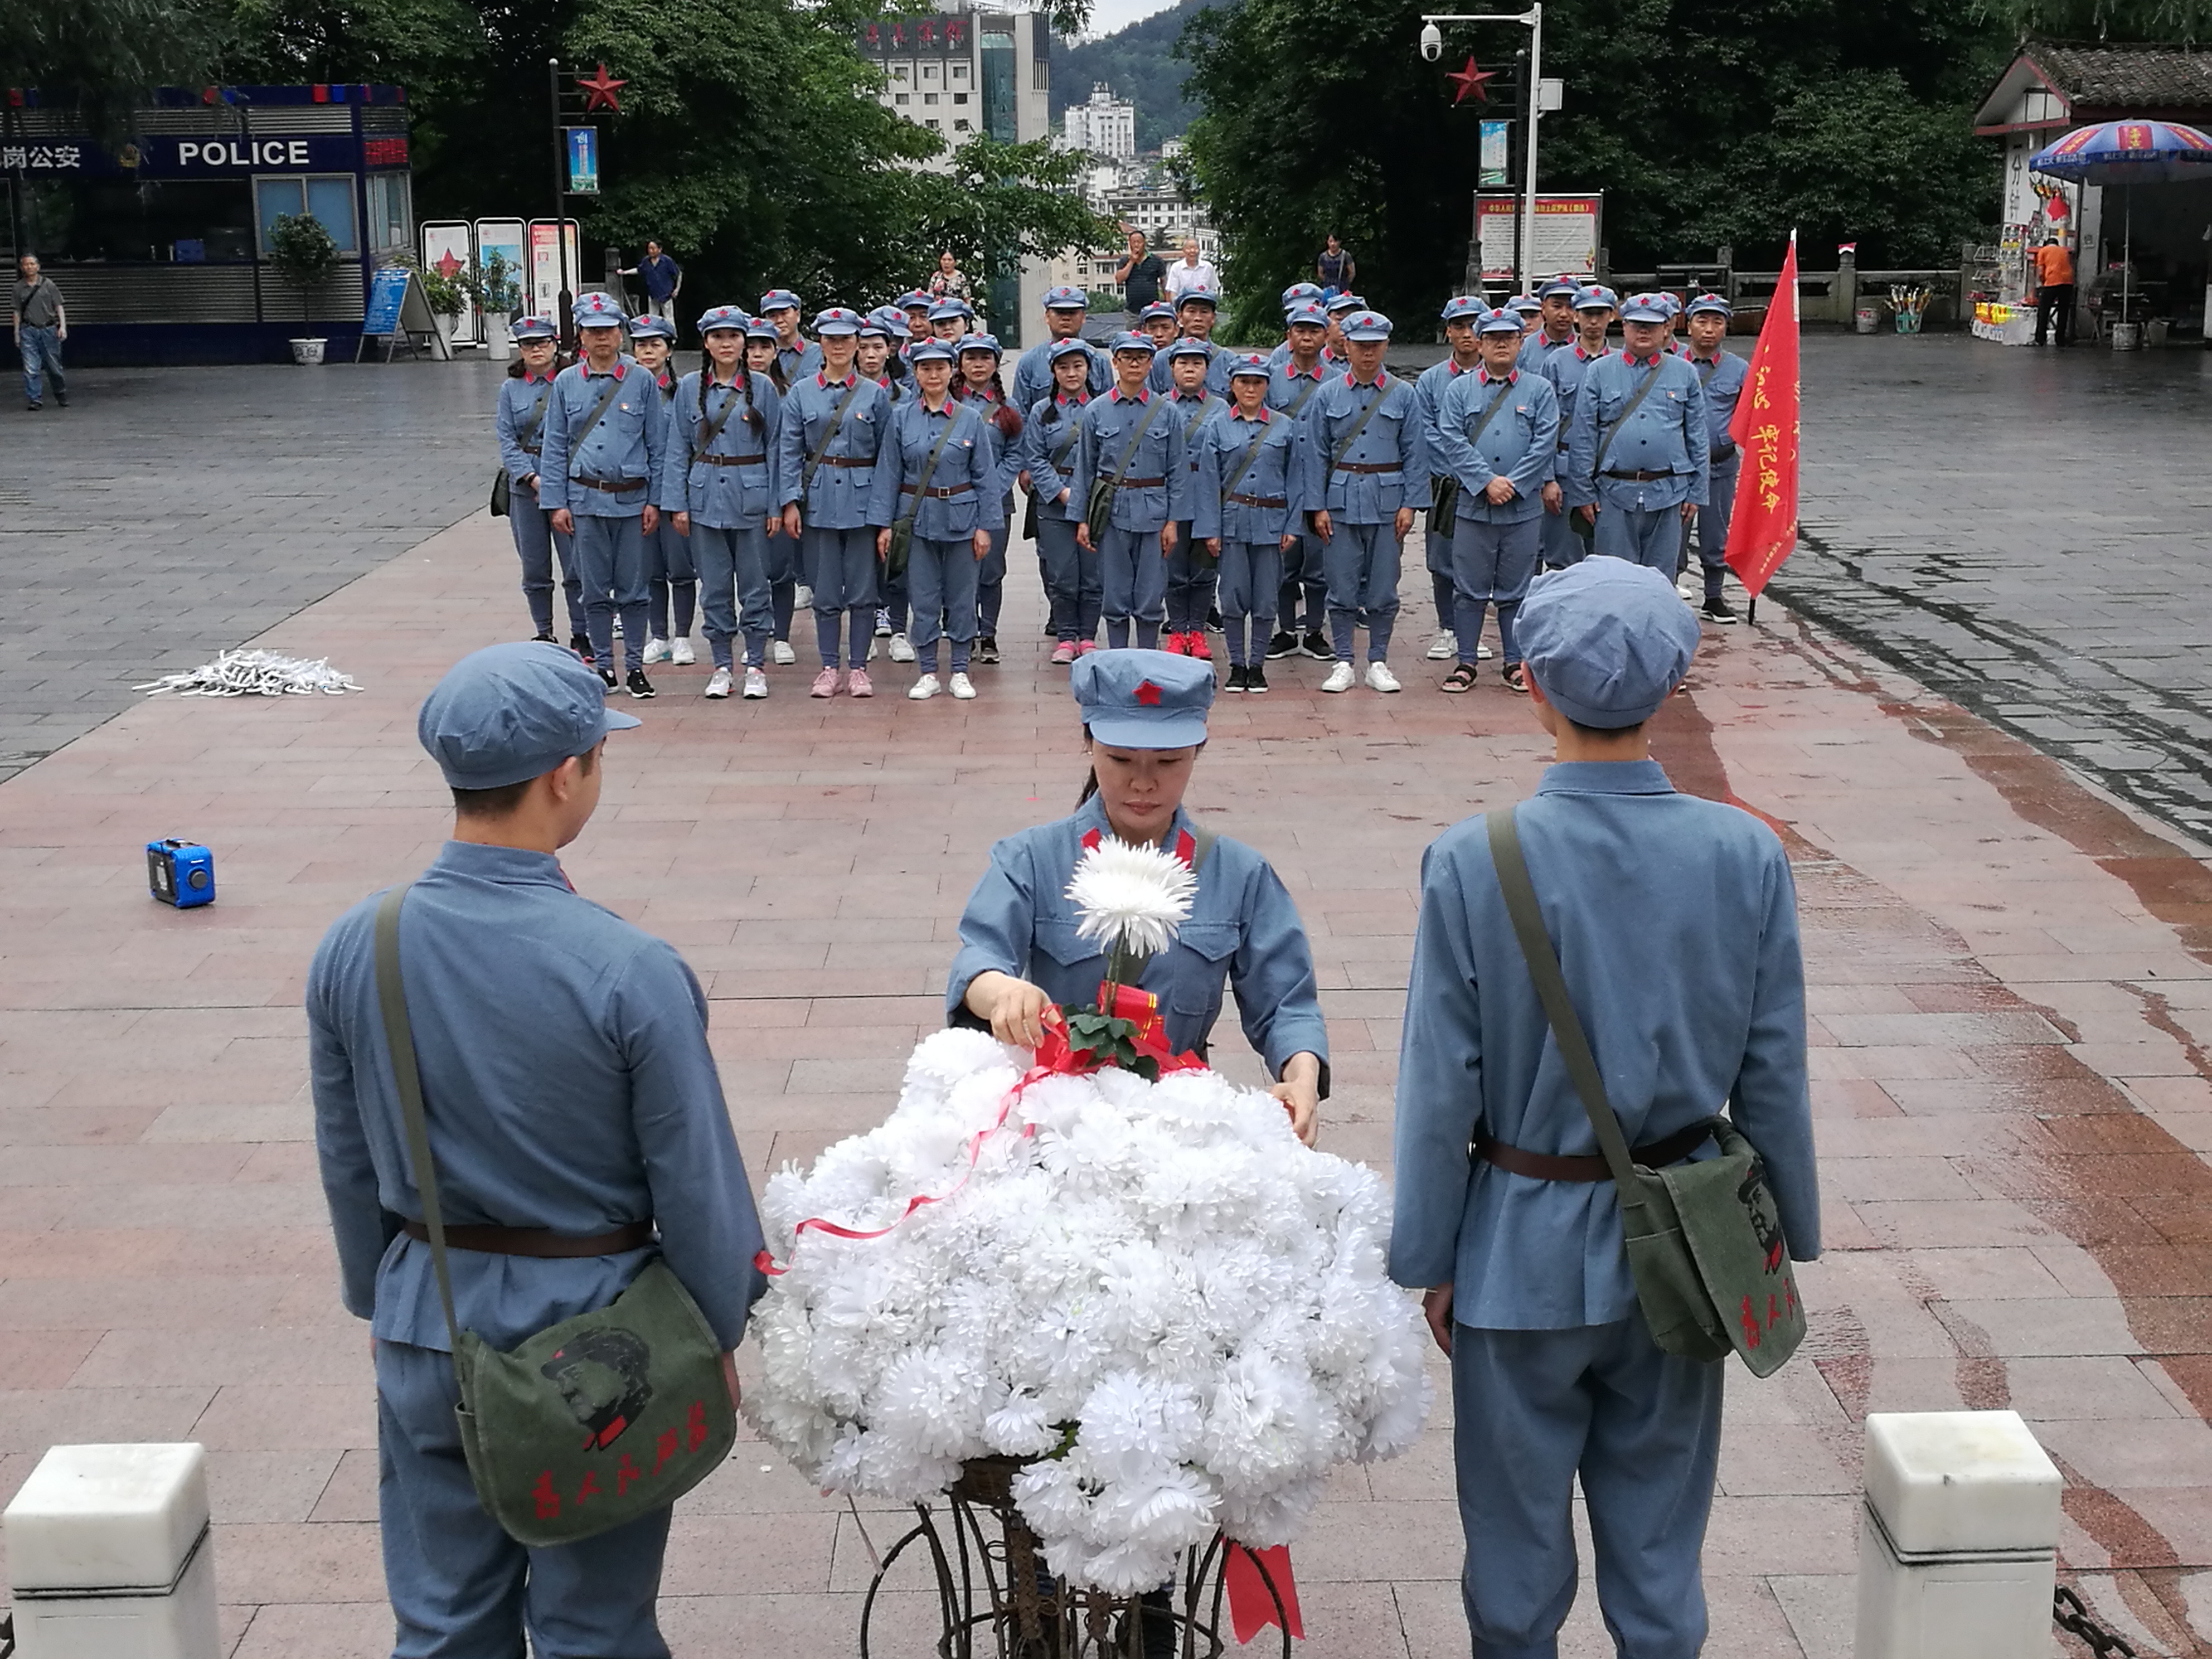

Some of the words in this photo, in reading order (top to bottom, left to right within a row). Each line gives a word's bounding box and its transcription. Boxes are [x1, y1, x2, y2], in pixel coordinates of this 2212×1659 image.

[178, 141, 309, 166] POLICE
[1750, 424, 1781, 515] 牢记使命
